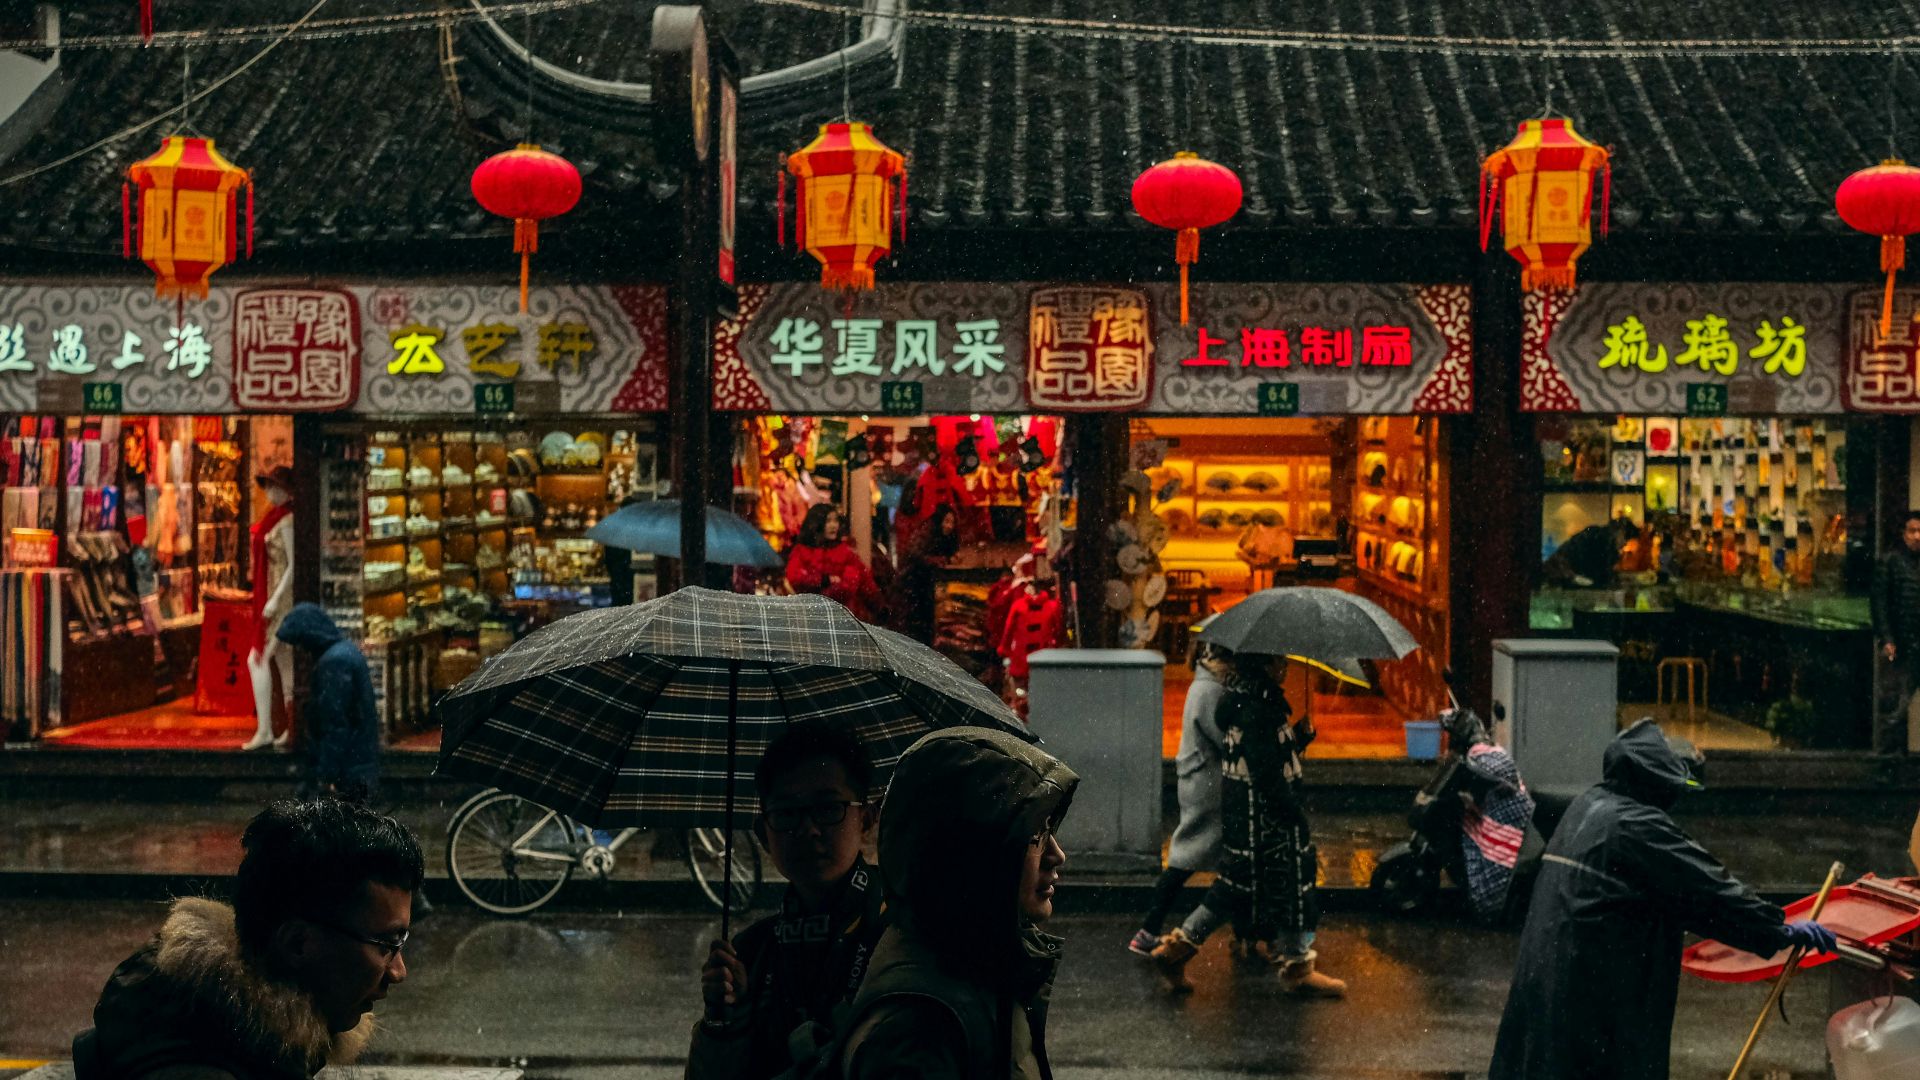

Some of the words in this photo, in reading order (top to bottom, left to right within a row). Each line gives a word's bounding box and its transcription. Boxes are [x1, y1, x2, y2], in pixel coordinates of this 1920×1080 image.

[769, 317, 1006, 376] 华夏风采
[1180, 324, 1413, 367] 上海制扇
[1599, 314, 1807, 376] 琉璃坊
[93, 385, 113, 401] 66
[484, 386, 504, 402] 66
[892, 384, 912, 401] 64
[1267, 386, 1288, 402] 64
[1696, 386, 1718, 403] 62
